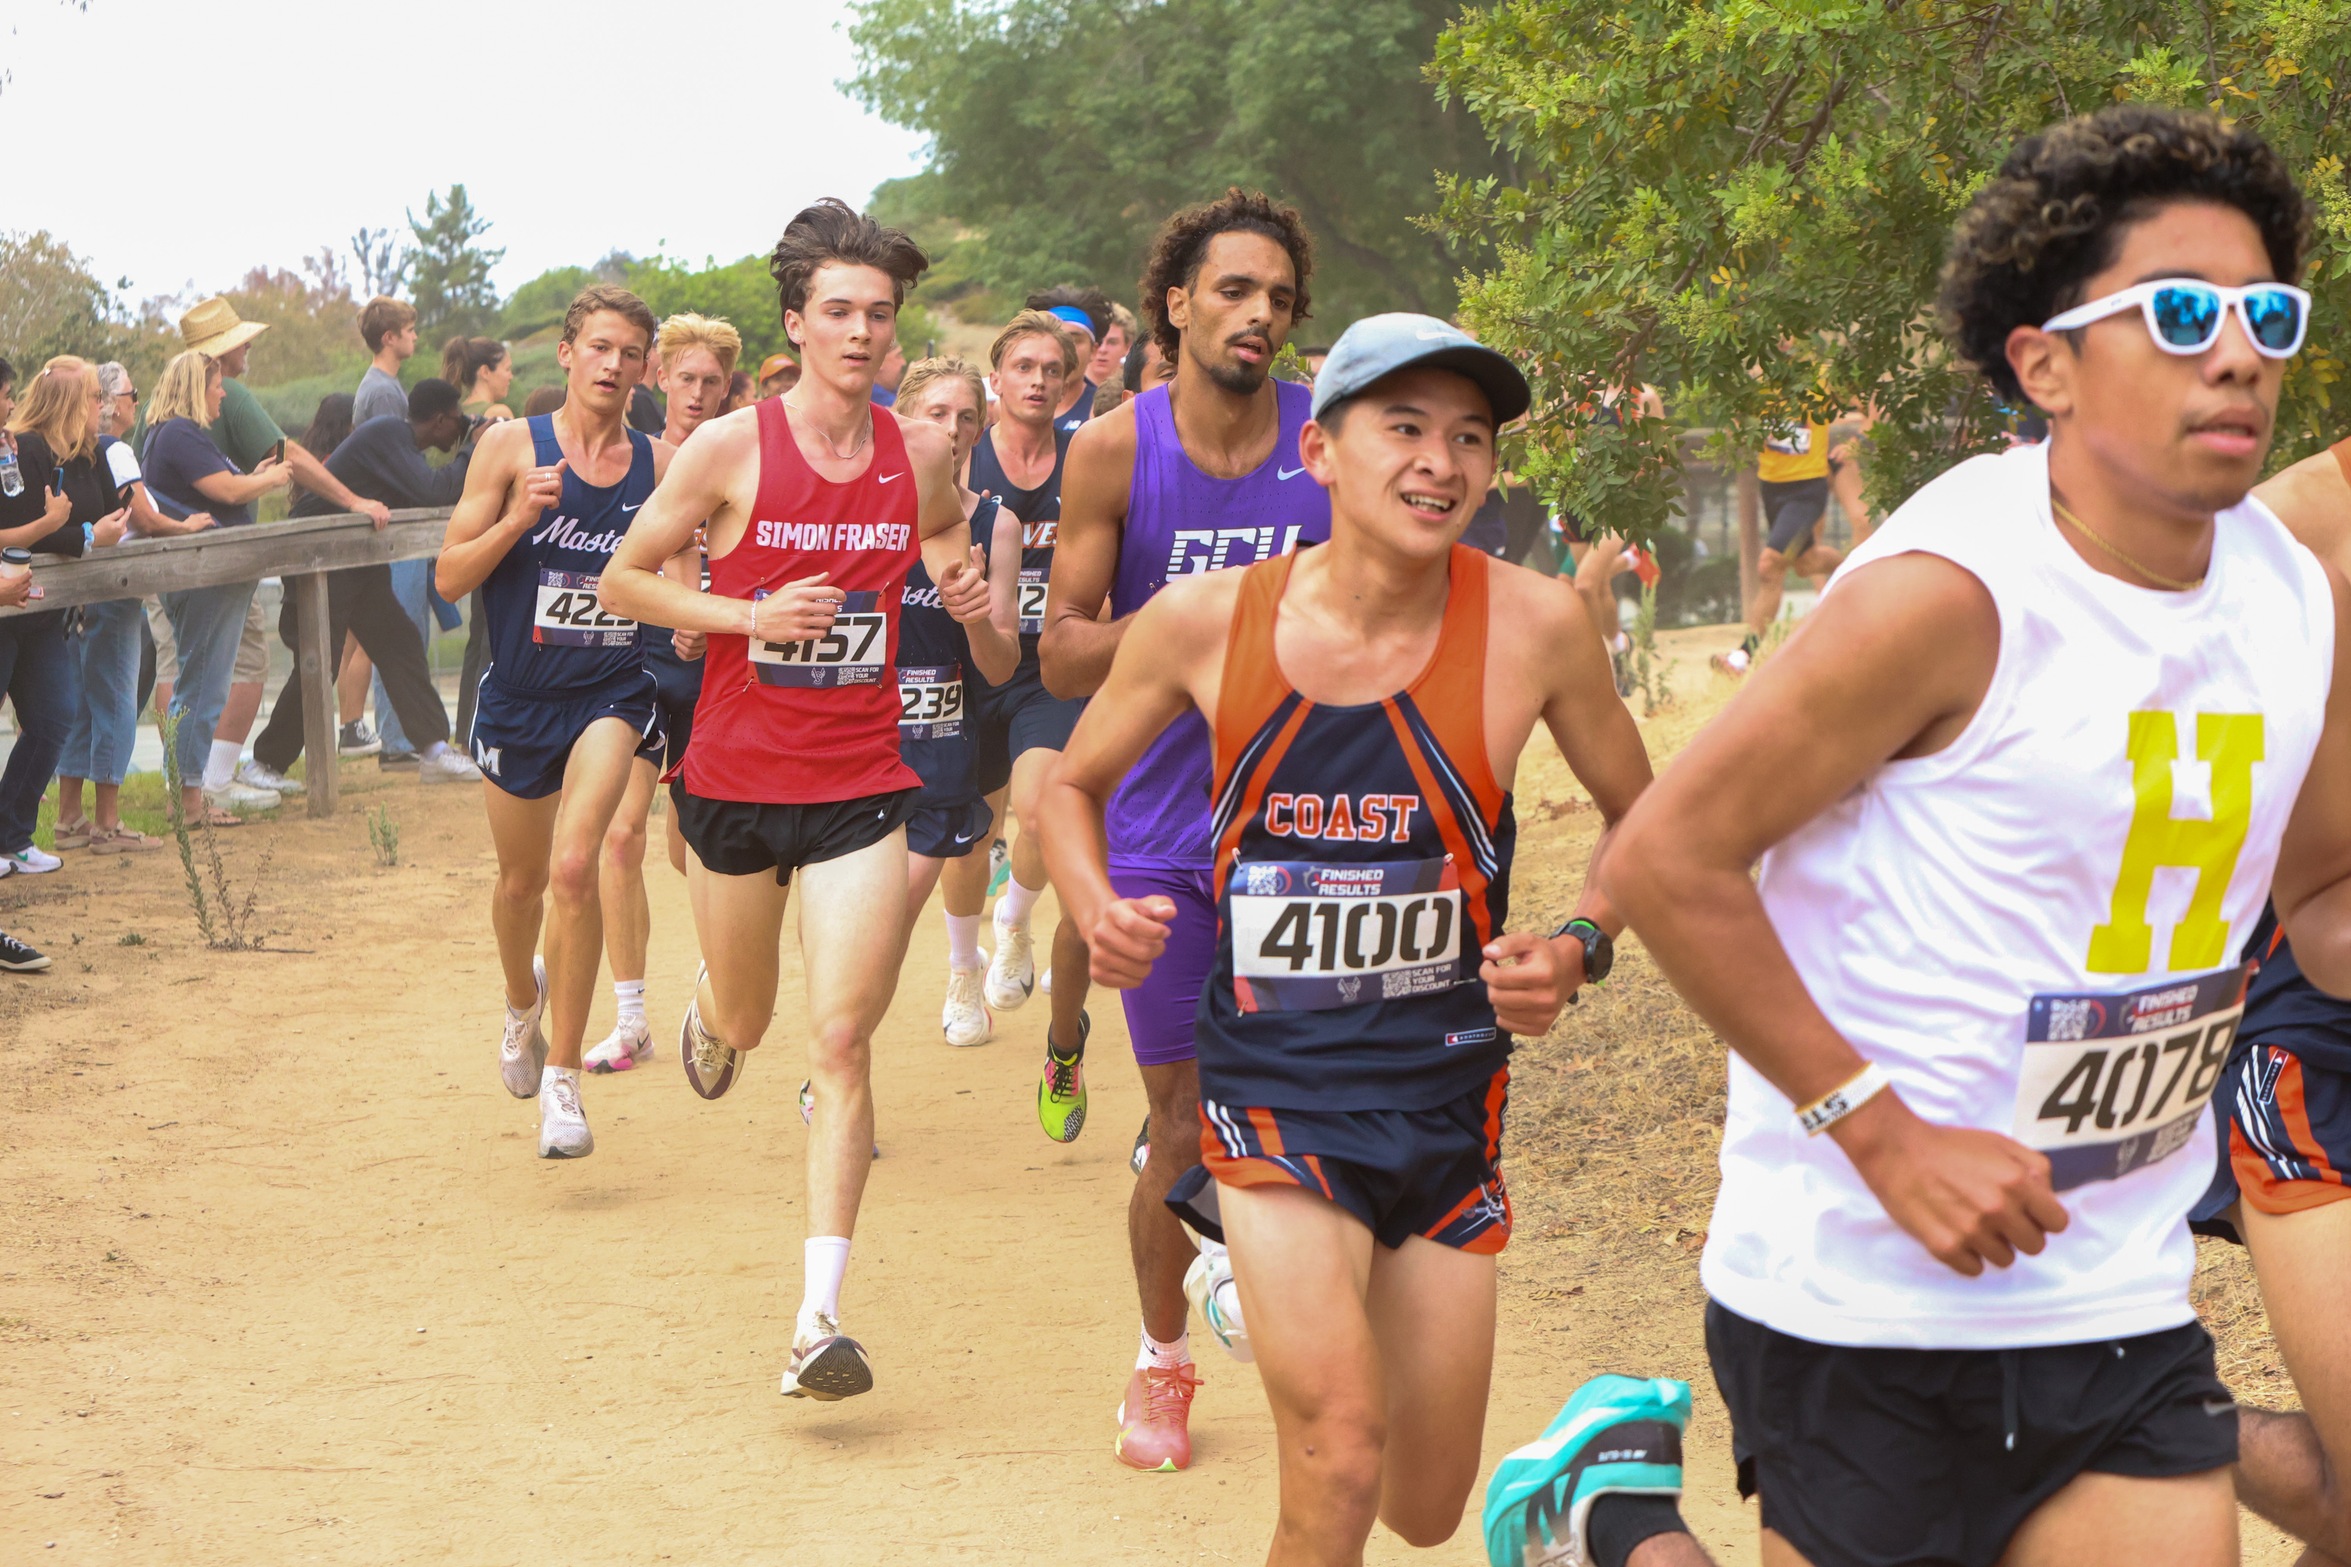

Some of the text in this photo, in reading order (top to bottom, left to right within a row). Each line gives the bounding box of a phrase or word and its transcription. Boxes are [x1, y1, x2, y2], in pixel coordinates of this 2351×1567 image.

[533, 515, 624, 553] Maste
[756, 520, 911, 551] SIMON FRASER
[901, 684, 962, 719] 239
[476, 736, 503, 777] M
[1265, 793, 1419, 843] COAST
[2087, 711, 2265, 973] H
[1318, 883, 1382, 896] RESULTS
[1321, 868, 1384, 881] FINISHED
[1259, 897, 1454, 971] 4100
[1412, 963, 1452, 976] SCAN FOR
[1412, 975, 1435, 985] YOUR
[1412, 979, 1451, 992] DISCOUNT
[2138, 984, 2199, 1012] FINISHED
[2131, 1005, 2193, 1034] RESULTS
[2037, 1015, 2237, 1134] 4078
